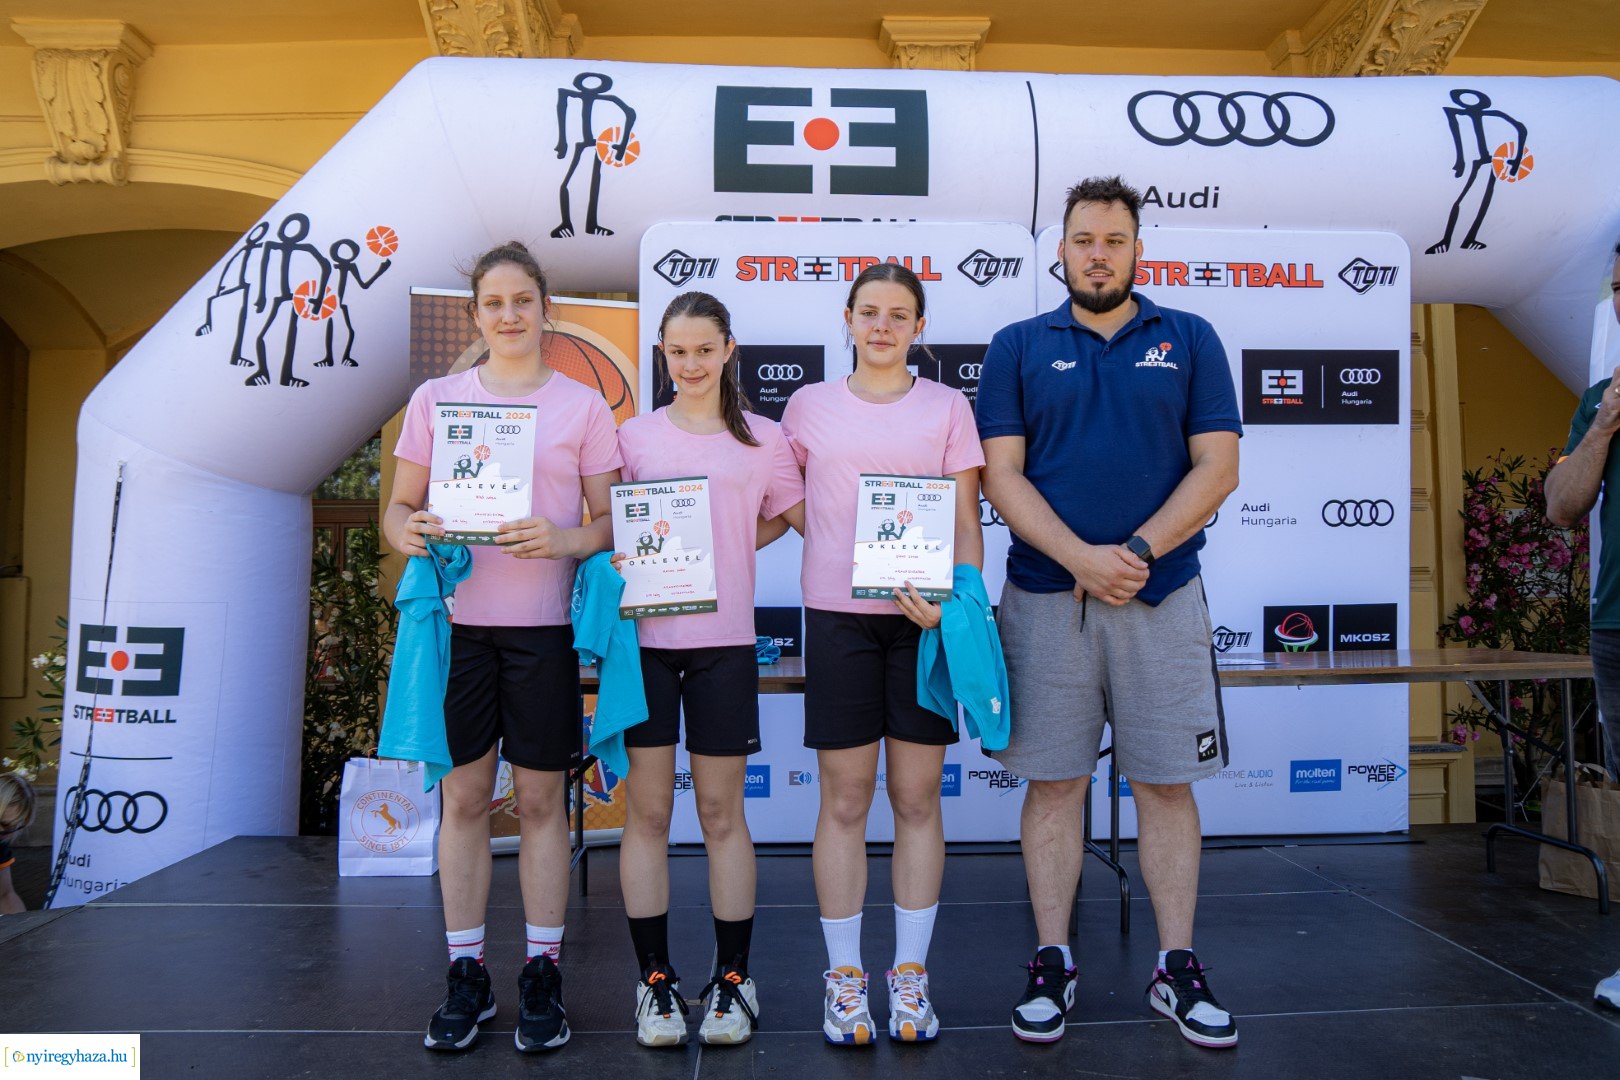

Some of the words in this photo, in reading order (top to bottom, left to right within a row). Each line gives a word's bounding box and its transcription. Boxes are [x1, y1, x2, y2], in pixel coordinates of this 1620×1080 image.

[1143, 185, 1220, 209] Audi
[668, 257, 720, 280] TOTI
[974, 256, 1024, 279] TOTI
[1352, 264, 1399, 287] TOTI
[440, 410, 502, 420] STREETBALL
[505, 411, 532, 420] 2024
[616, 486, 676, 498] STREETBALL
[678, 484, 704, 493] 2024
[865, 480, 923, 489] STREETBALL
[925, 482, 950, 490] 2024
[1241, 503, 1270, 512] Audi
[1241, 516, 1297, 528] Hungaria
[1216, 631, 1252, 648] TOTI
[1340, 633, 1391, 643] MKOSZ
[73, 704, 177, 724] STREETBALL
[1247, 769, 1274, 779] AUDIO
[1296, 768, 1336, 779] molten
[1348, 765, 1396, 774] POWER
[989, 780, 1019, 788] ADE
[1368, 774, 1395, 783] ADE
[356, 791, 414, 814] CONTINENTAL
[360, 835, 388, 852] SINCE
